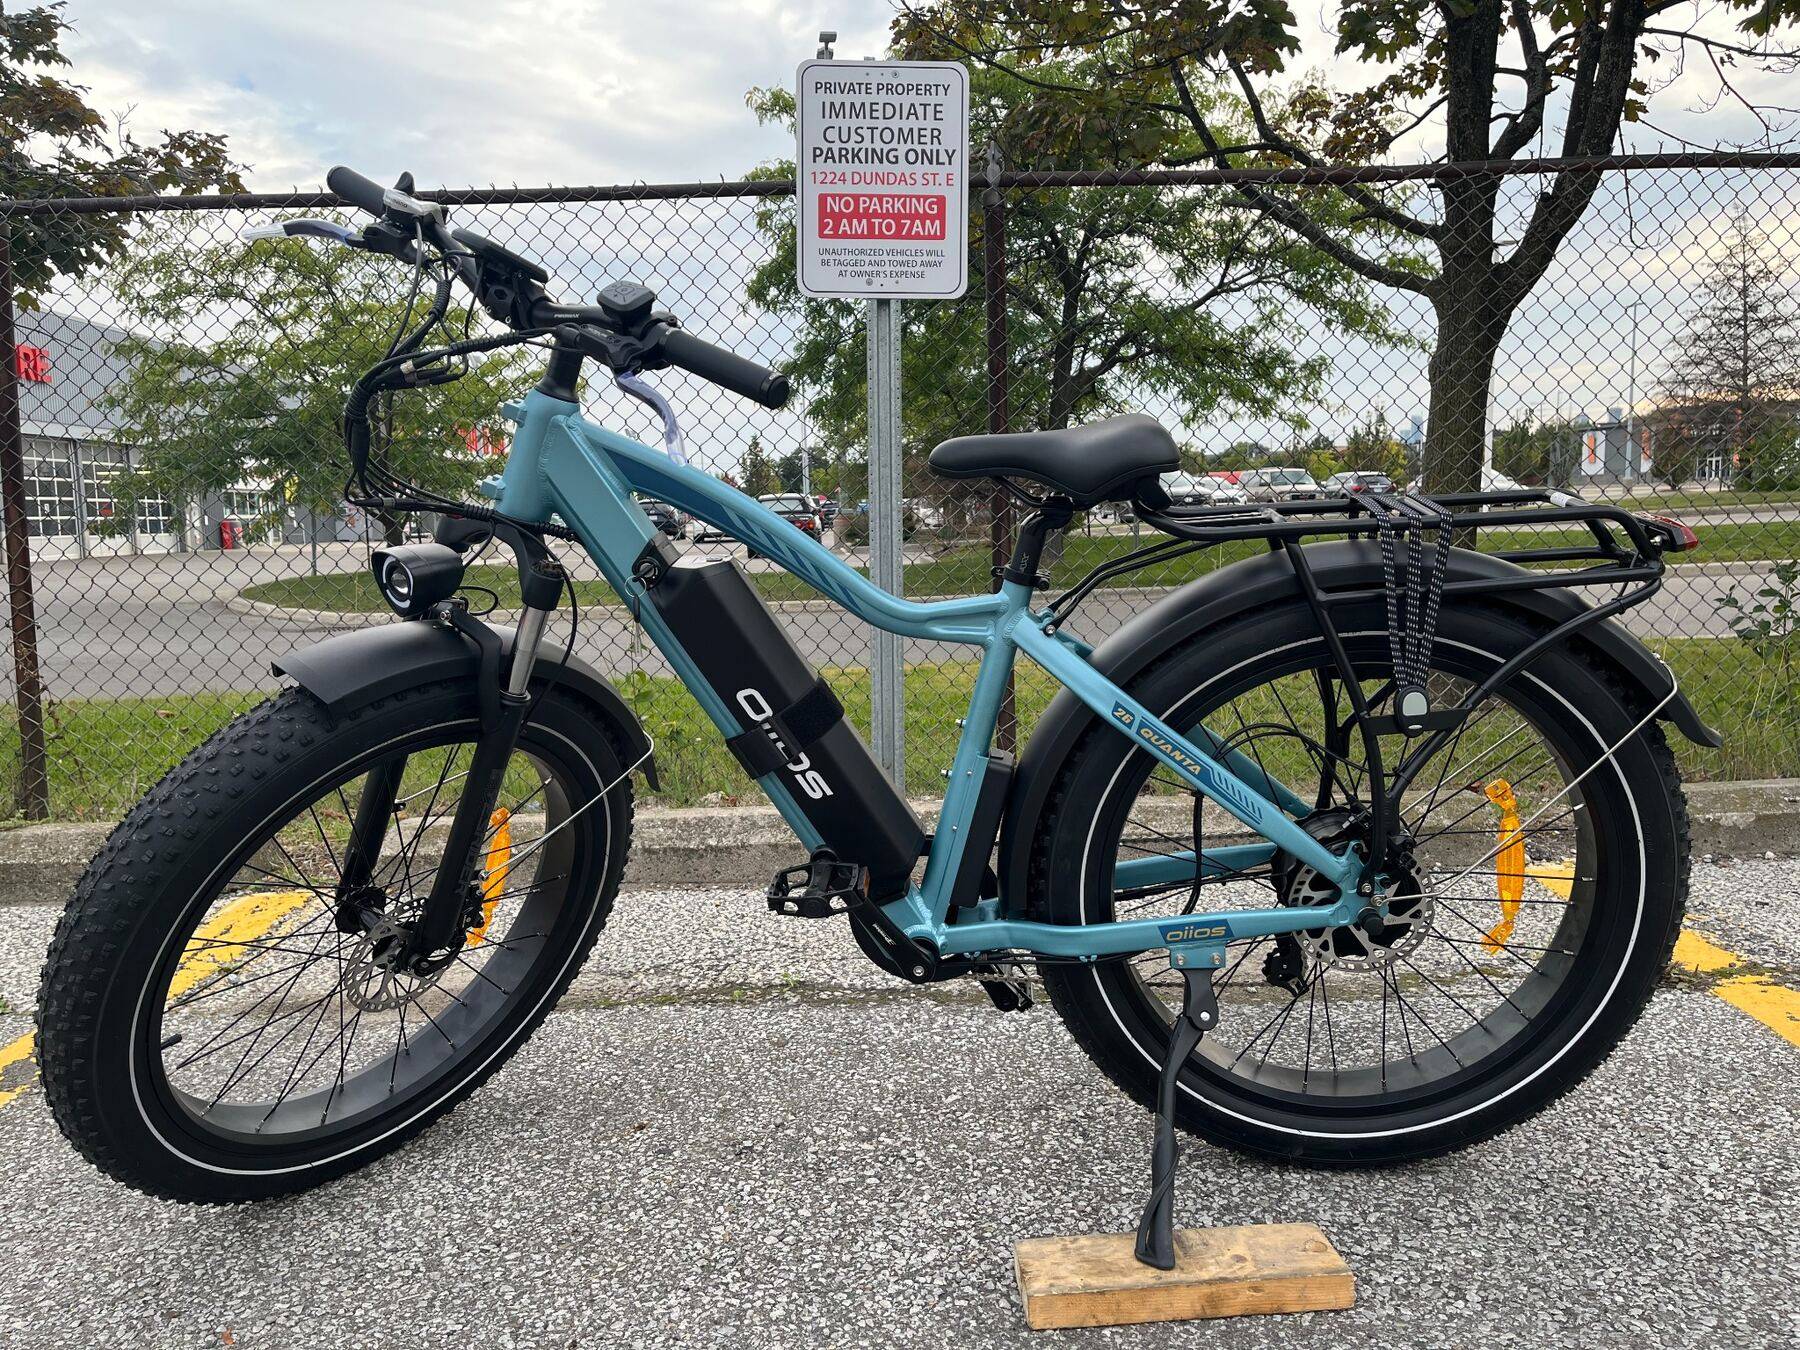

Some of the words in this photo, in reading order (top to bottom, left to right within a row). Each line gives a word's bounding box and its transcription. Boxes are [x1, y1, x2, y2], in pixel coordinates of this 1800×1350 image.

[815, 81, 873, 95] PRIVATE
[876, 82, 951, 97] PROPERTY
[821, 101, 944, 121] IMMEDIATE
[822, 126, 943, 146] CUSTOMER
[812, 146, 899, 165] PARKING
[904, 148, 957, 166] ONLY
[811, 171, 848, 185] 1224
[851, 171, 918, 187] DUNDAS
[921, 172, 942, 187] ST.
[946, 173, 955, 187] E
[826, 196, 854, 213] NO
[859, 196, 938, 215] PARKING
[823, 219, 834, 235] 2
[838, 219, 868, 235] AM
[872, 219, 896, 235] TO
[901, 219, 942, 236] 7AM
[818, 247, 885, 257] UNAUTHORIZED
[885, 248, 925, 258] VEHICLES
[925, 248, 946, 258] WILL
[820, 258, 831, 267] BE
[831, 258, 866, 268] TAGGED
[867, 258, 886, 267] AND
[887, 259, 918, 268] TOWED
[919, 259, 943, 268] AWAY
[837, 269, 848, 278] AT
[849, 269, 888, 279] OWNER'S
[889, 270, 926, 279] EXPENSE
[1113, 708, 1134, 724] 26
[1140, 728, 1201, 775] QUANTA
[1166, 925, 1227, 941] oiios
